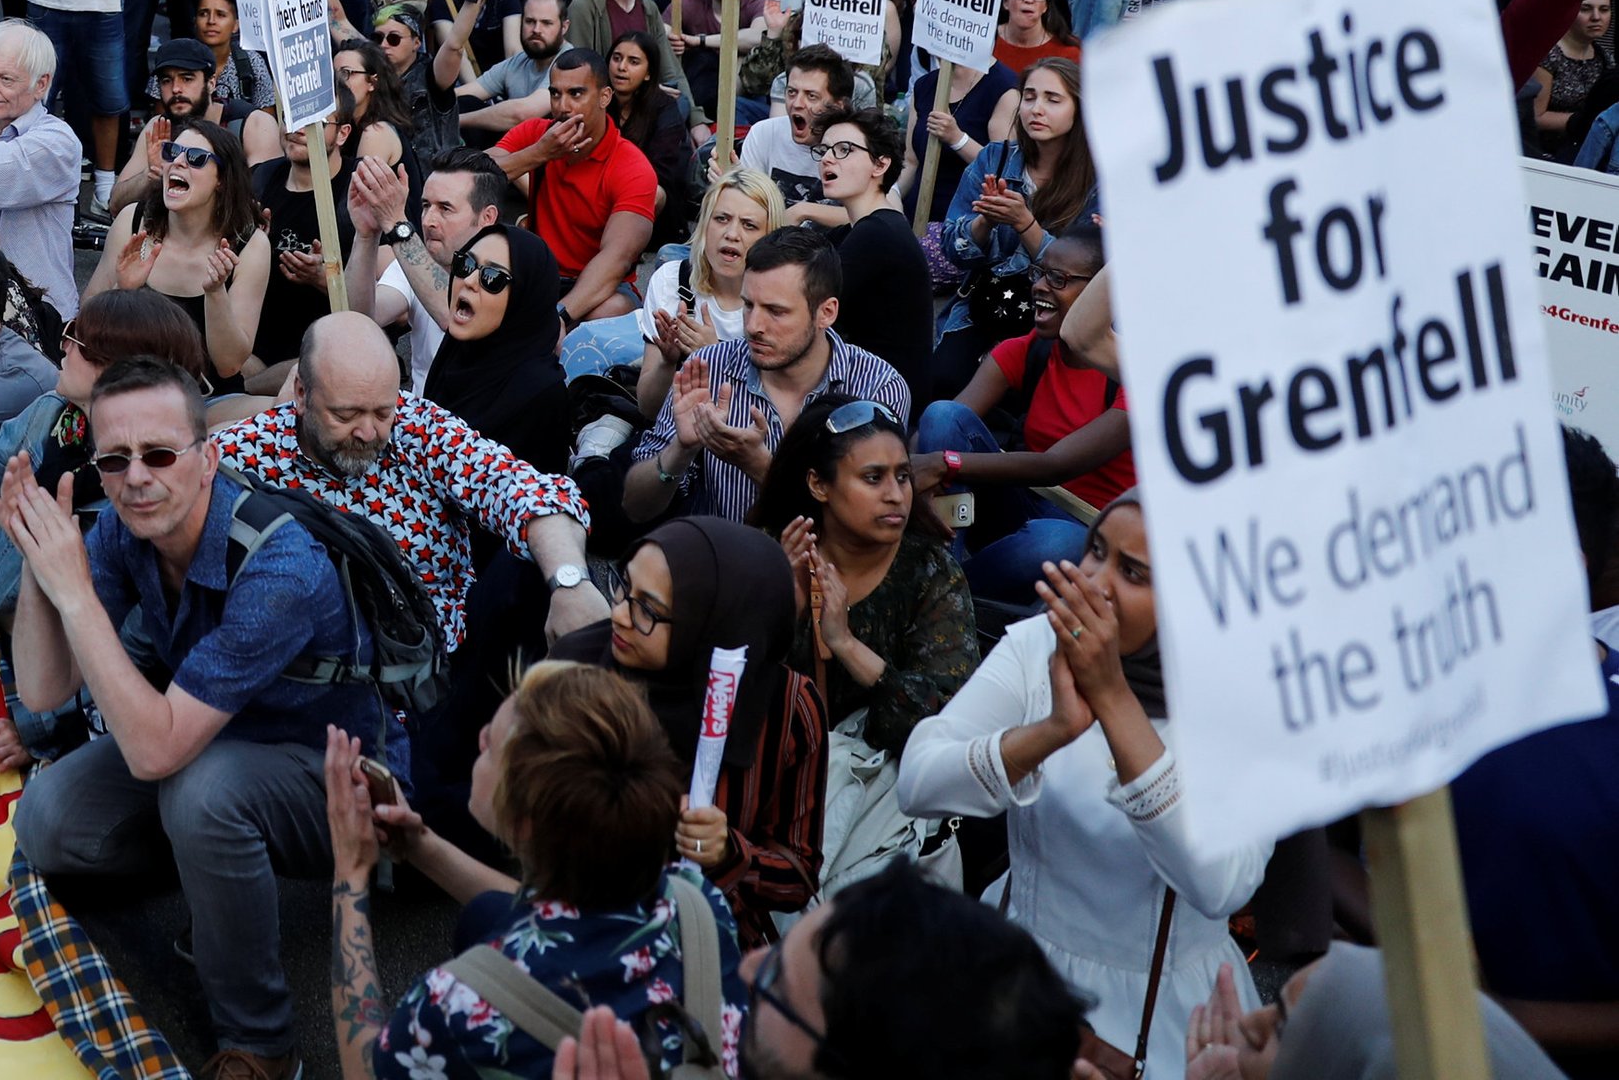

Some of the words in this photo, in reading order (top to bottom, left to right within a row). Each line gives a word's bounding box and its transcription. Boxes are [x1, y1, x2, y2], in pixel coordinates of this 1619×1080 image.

[809, 10, 828, 28] We
[830, 14, 879, 35] demand
[838, 33, 866, 51] truth
[927, 22, 943, 42] the
[945, 29, 974, 53] truth
[939, 8, 990, 39] demand
[1151, 12, 1447, 186] Justice
[1262, 177, 1389, 306] for
[1163, 262, 1518, 486] Grenfell
[1186, 516, 1303, 629] We
[1272, 625, 1380, 732] the
[1392, 559, 1503, 693] truth
